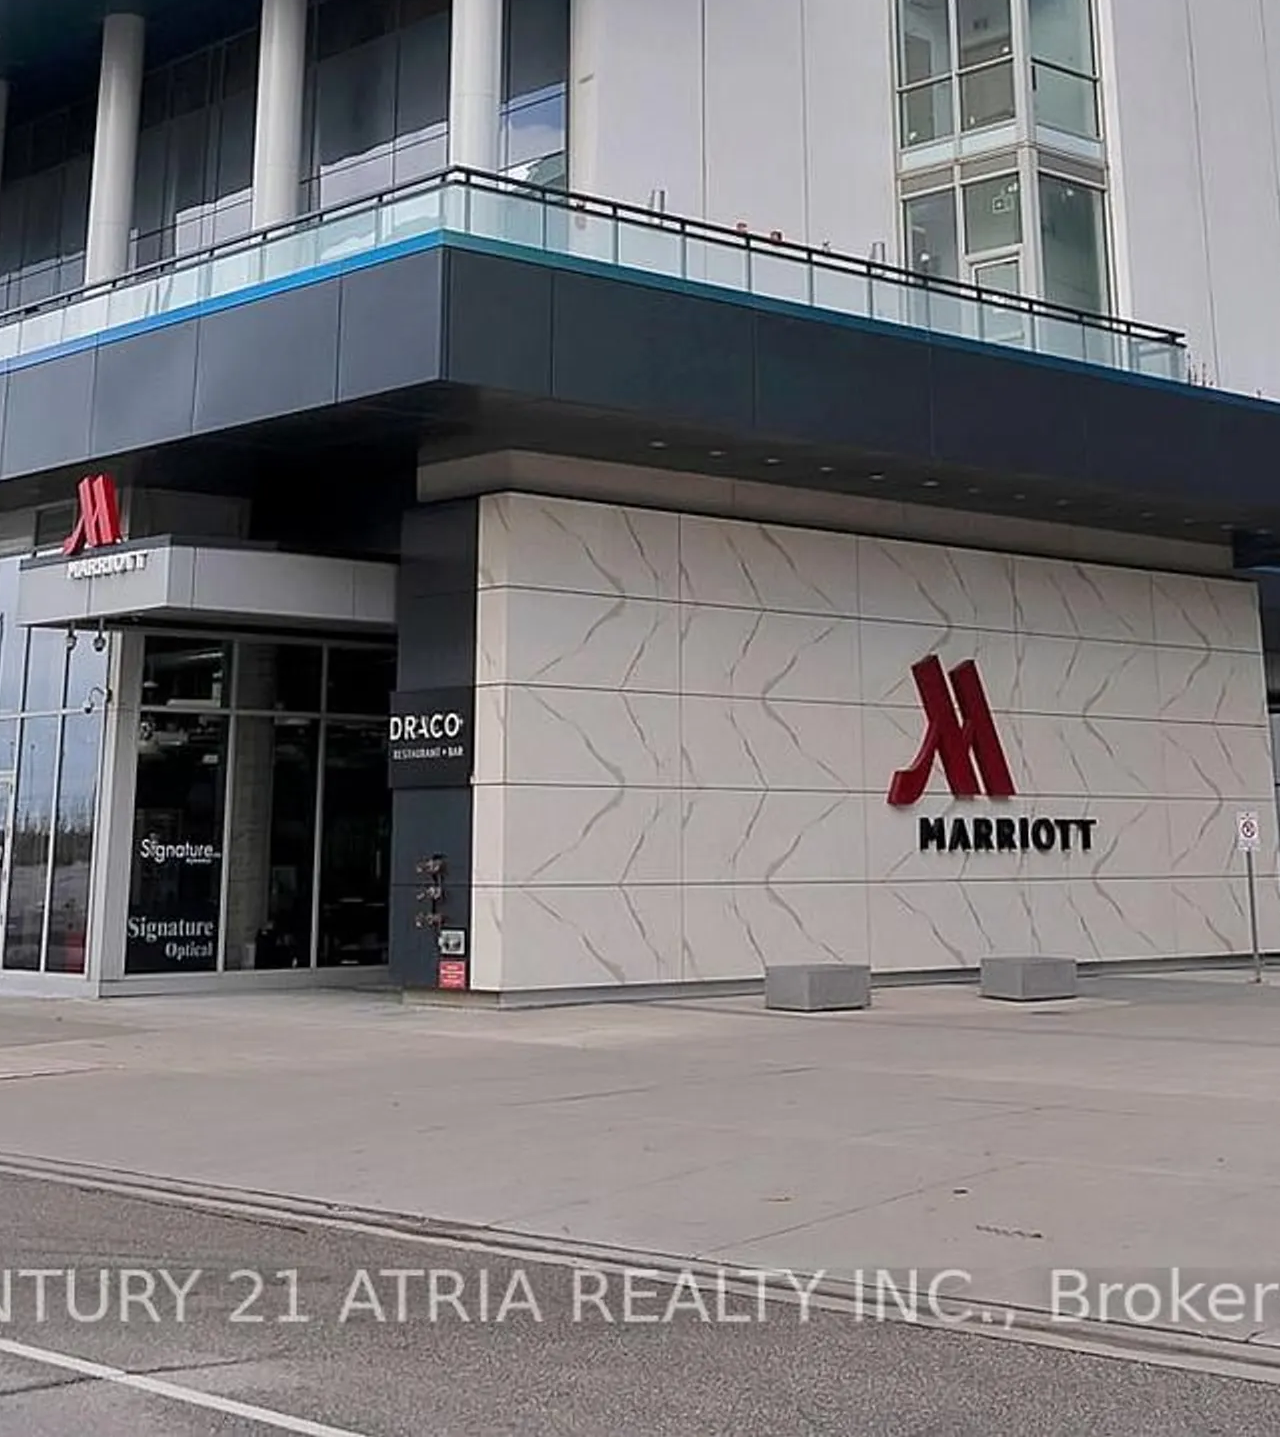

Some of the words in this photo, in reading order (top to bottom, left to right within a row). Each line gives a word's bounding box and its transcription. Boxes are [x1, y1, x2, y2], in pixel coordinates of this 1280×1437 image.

[66, 552, 147, 579] MARRIOTT
[389, 713, 460, 741] DRACO
[919, 816, 1097, 852] MARRIOTT
[140, 838, 213, 864] Signature
[128, 916, 214, 943] Signature
[165, 941, 213, 961] Optical
